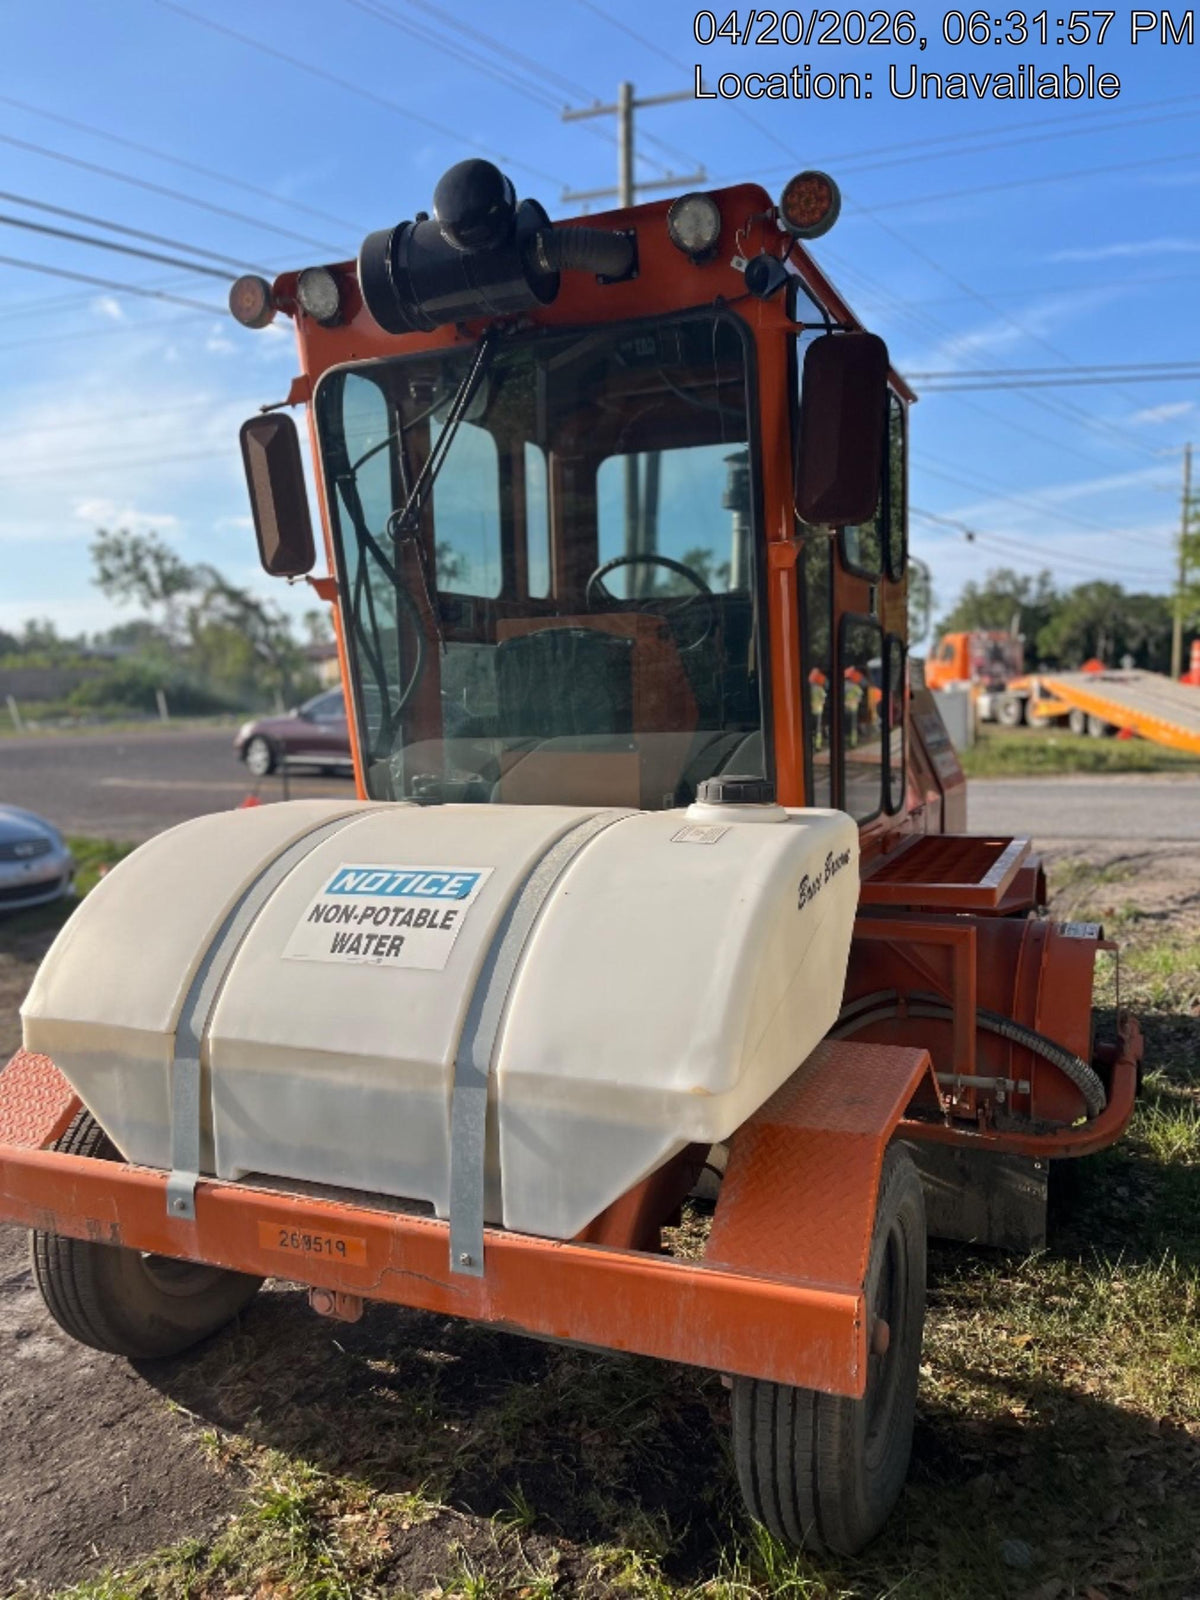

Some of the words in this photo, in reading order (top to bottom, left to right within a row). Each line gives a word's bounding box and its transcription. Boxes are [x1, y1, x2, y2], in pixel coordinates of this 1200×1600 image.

[331, 871, 474, 895] NOTICE
[307, 904, 458, 930] NON-POTABLE
[329, 932, 405, 957] WATER
